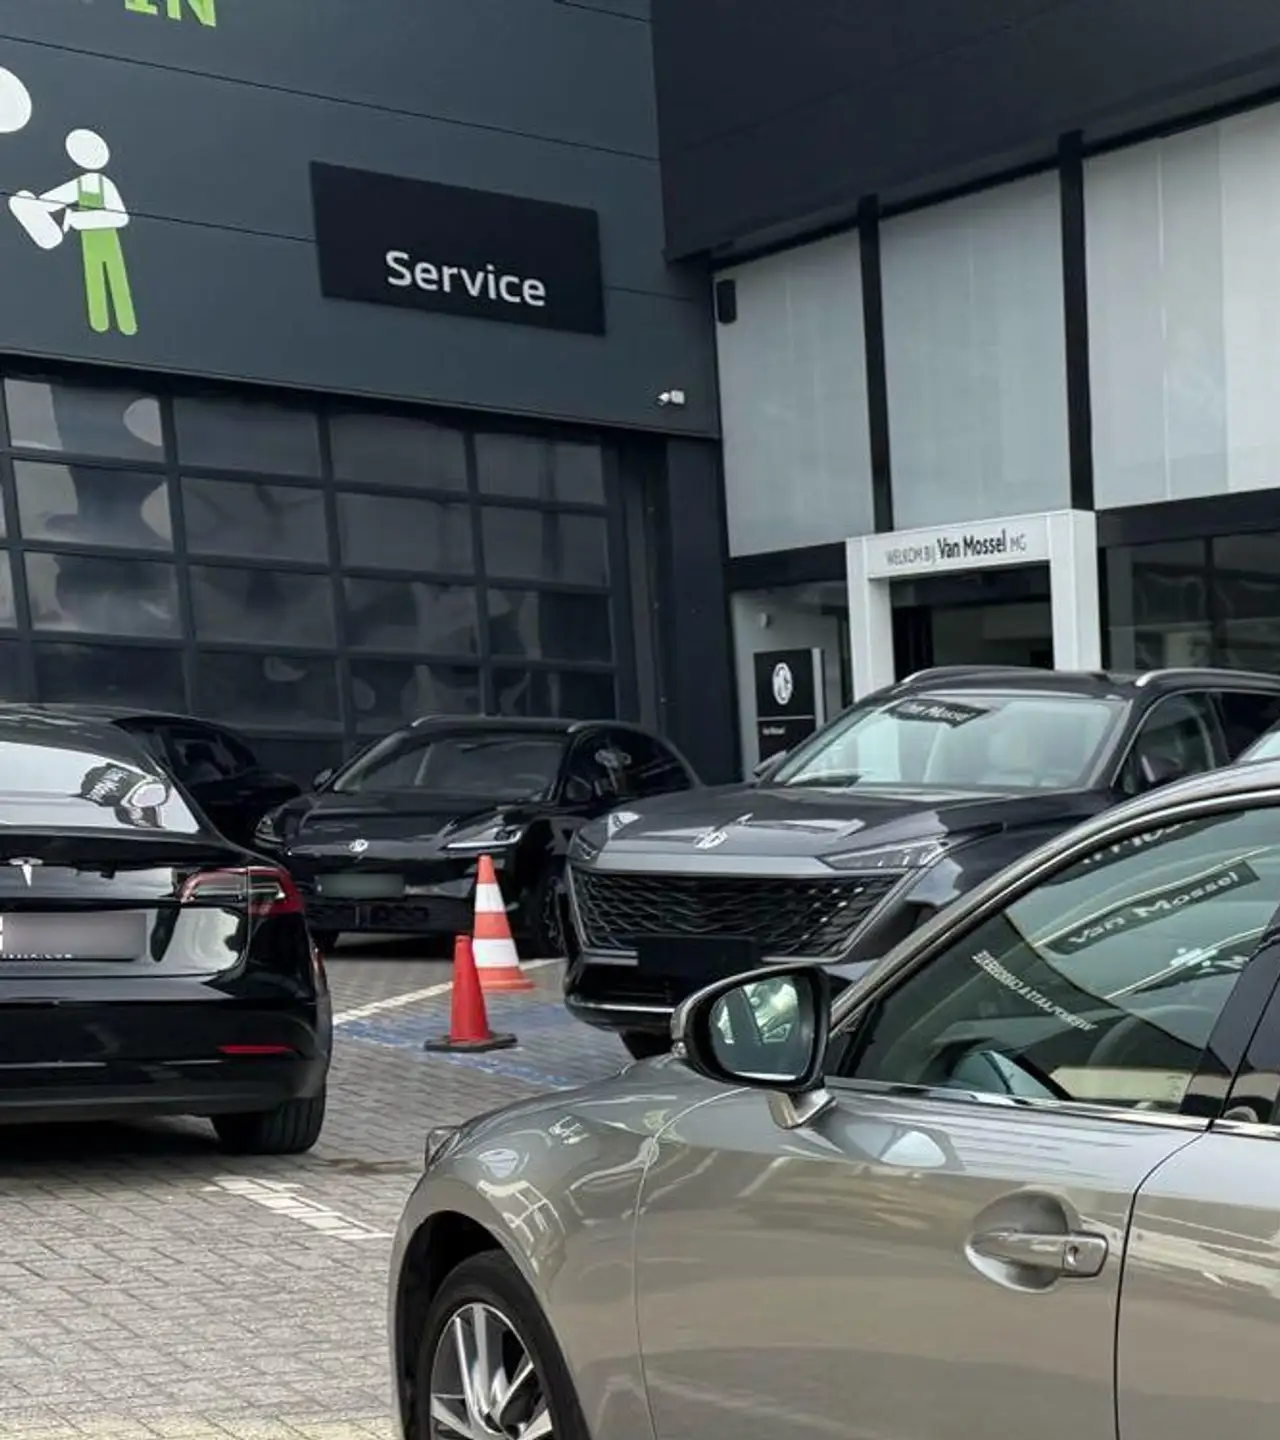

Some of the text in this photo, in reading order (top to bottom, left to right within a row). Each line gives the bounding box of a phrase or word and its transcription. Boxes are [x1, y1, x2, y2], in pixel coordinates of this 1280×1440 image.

[384, 249, 547, 307] Service
[937, 537, 960, 559] Van
[963, 528, 1007, 556] Mossel
[1009, 533, 1027, 552] MG
[1067, 870, 1241, 944] Van Mossel
